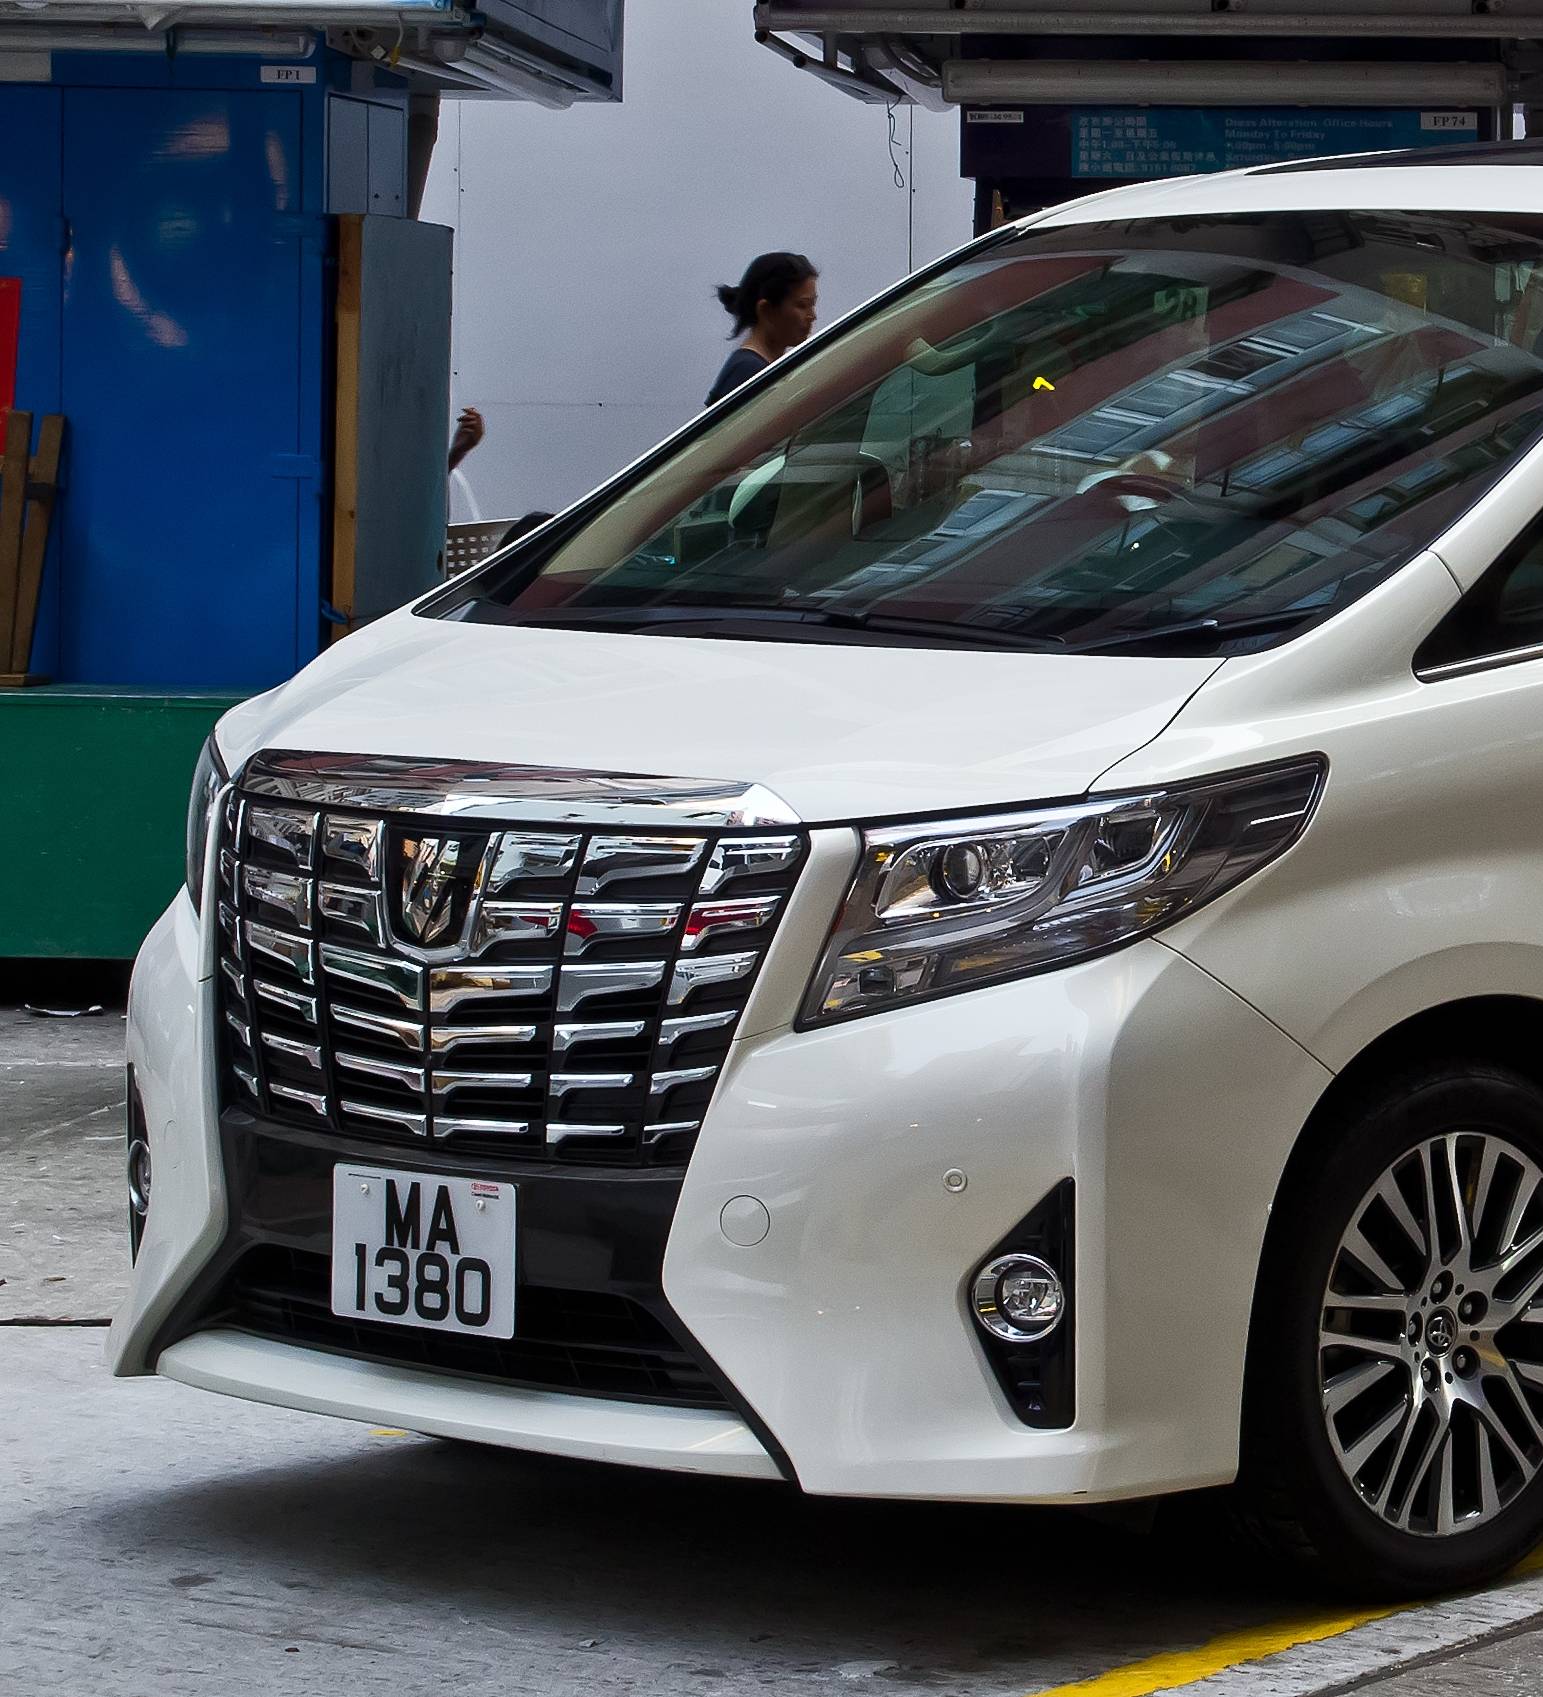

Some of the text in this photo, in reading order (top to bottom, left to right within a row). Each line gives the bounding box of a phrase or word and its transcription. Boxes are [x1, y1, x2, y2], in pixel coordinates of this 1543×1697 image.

[1225, 129, 1270, 140] Monday
[1290, 129, 1326, 140] Friday
[1323, 118, 1356, 128] Office
[385, 1178, 461, 1256] MA
[354, 1242, 492, 1328] 1380
